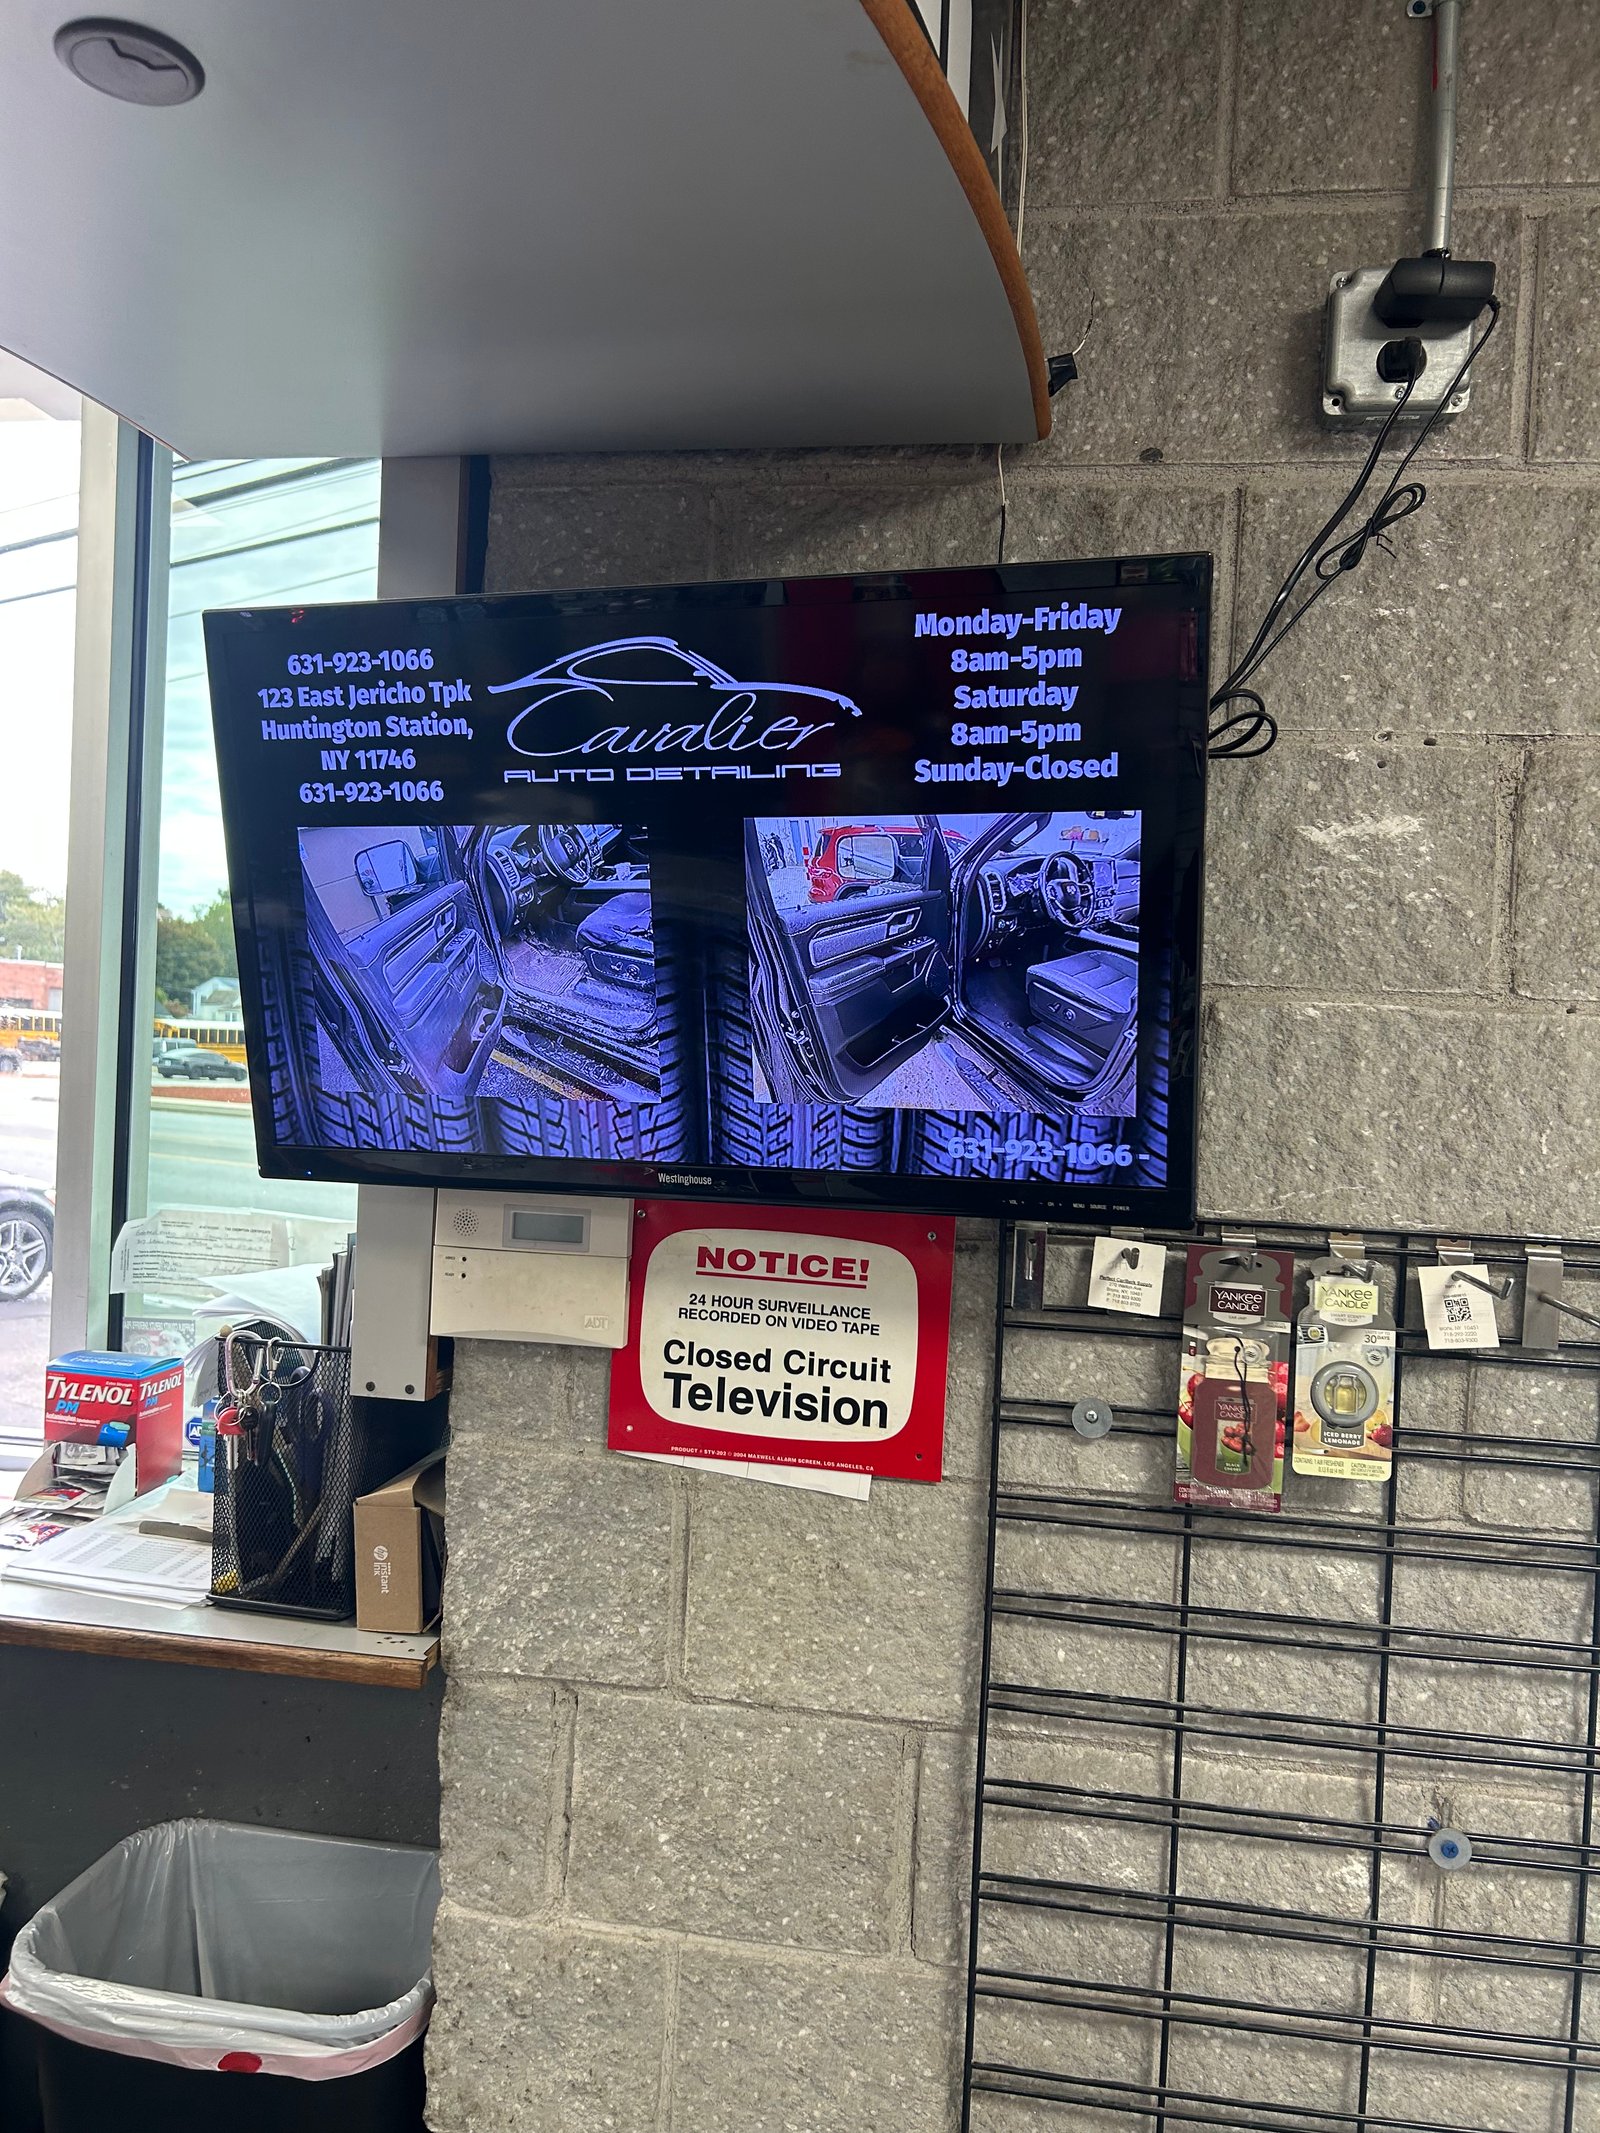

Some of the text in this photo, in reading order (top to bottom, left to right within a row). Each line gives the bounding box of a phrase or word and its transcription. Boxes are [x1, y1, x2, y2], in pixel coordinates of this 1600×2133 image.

[915, 602, 1122, 639] Monday-Friday
[287, 648, 434, 676] 631-923-1066
[950, 645, 1083, 676] 8am-5pm
[258, 678, 473, 712] 123 East Jericho Tpk
[953, 680, 1080, 712] Saturday
[261, 712, 474, 745] Huntington Station,
[506, 687, 836, 757] Cavalier
[950, 719, 1082, 750] 8am-5pm
[320, 748, 417, 771] NY 11746
[503, 763, 842, 784] AUTO DETAILING
[914, 751, 1119, 788] Sunday-Closed
[299, 780, 445, 805] 631-923-1066
[947, 1136, 1133, 1167] 631-923-1066
[657, 1172, 713, 1187] Westinghouse
[696, 1246, 870, 1282] NOTICE!
[689, 1293, 871, 1319] 24 HOUR SURVEILLANCE
[584, 1316, 608, 1329] ADT
[678, 1307, 880, 1337] RECORDED ON VIDEO TAPE
[1364, 1334, 1377, 1344] 30
[663, 1338, 892, 1384] Closed Circuit
[46, 1375, 133, 1406] TYLENOL
[140, 1373, 182, 1402] TYLENOL
[145, 1396, 159, 1408] PM
[663, 1371, 889, 1429] Television
[55, 1399, 80, 1415] PM
[189, 1426, 202, 1437] AD
[1324, 1437, 1361, 1446] LEMONADE
[1341, 1432, 1362, 1440] BERRY
[671, 1446, 698, 1454] PRODUCT
[748, 1453, 776, 1461] MAXWELL
[373, 1546, 388, 1560] hp
[380, 1562, 389, 1594] instant
